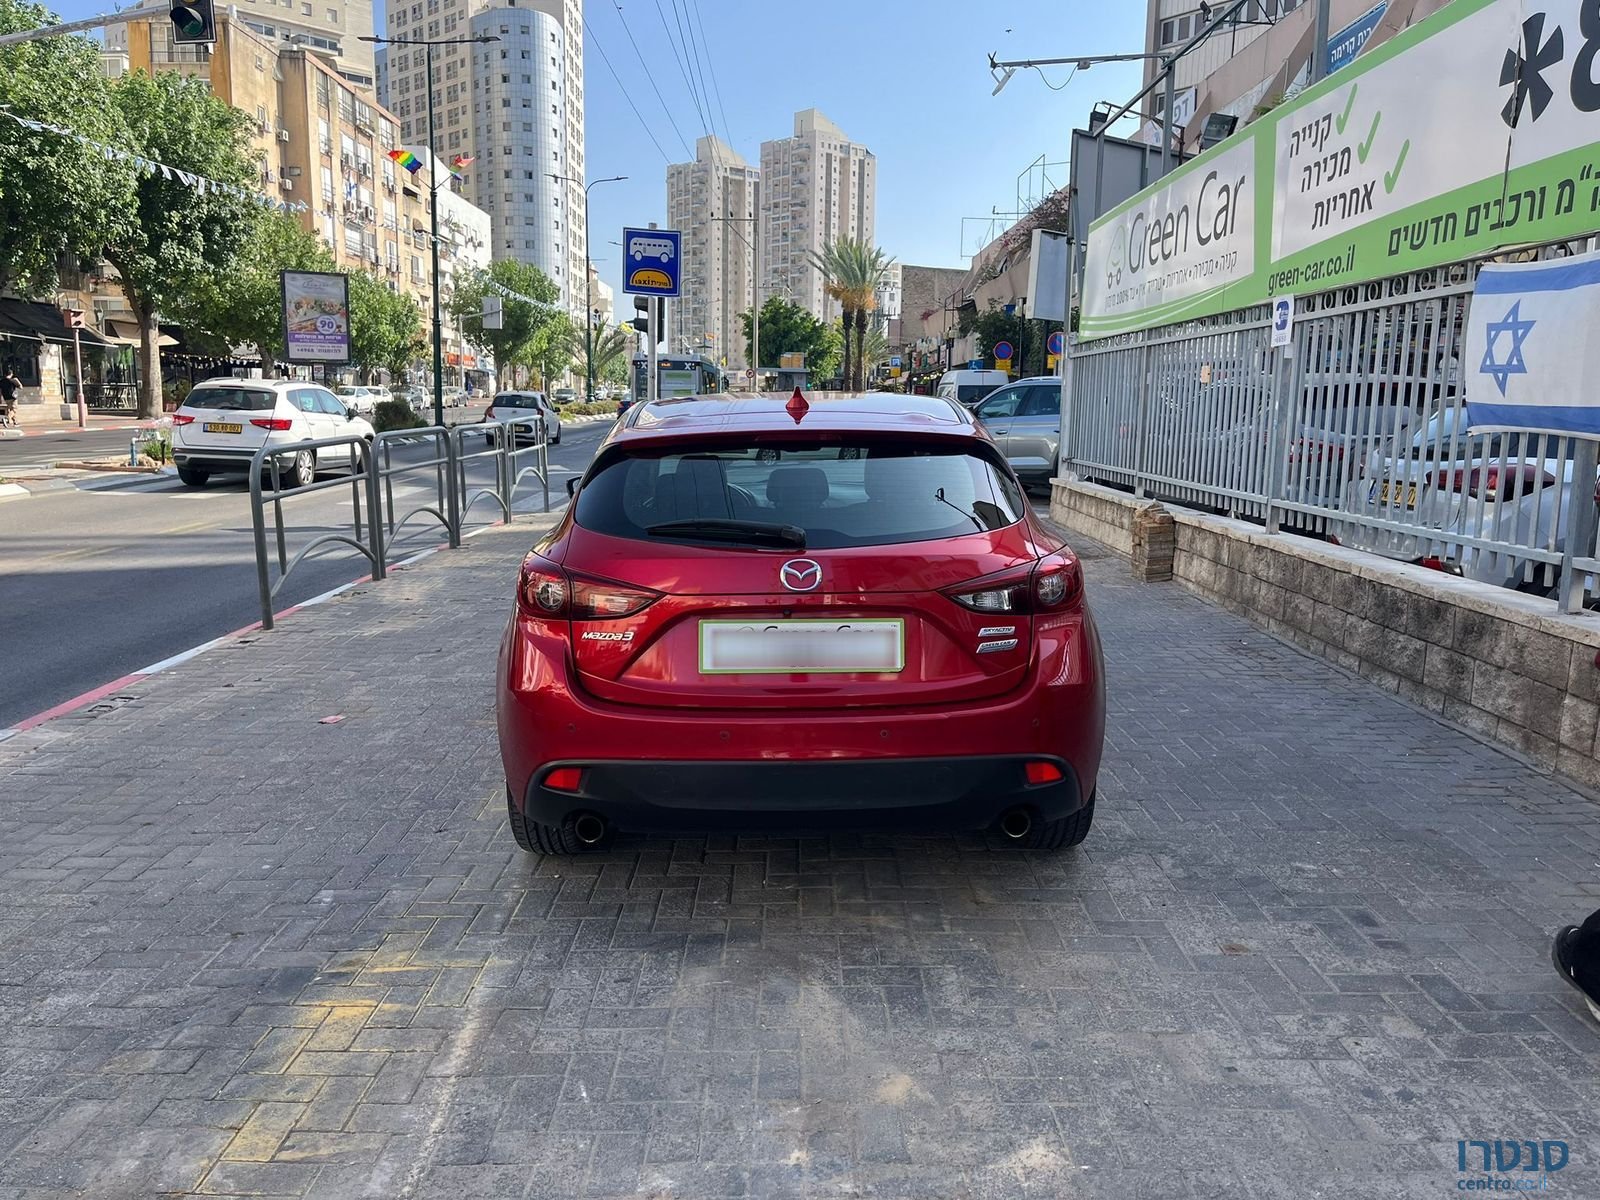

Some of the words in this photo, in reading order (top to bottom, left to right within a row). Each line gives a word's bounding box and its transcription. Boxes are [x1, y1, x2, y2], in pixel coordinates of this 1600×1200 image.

[1331, 37, 1355, 63] קדימה
[1290, 113, 1332, 158] קנייה
[1301, 146, 1351, 193] מכירה
[1129, 204, 1189, 274] Green
[1196, 170, 1245, 246] Car
[1311, 180, 1376, 231] אחריות
[1464, 186, 1546, 237] ורכבים
[1388, 212, 1457, 257] חדשים
[1268, 244, 1356, 296] green-car.co.il
[320, 320, 334, 329] 90
